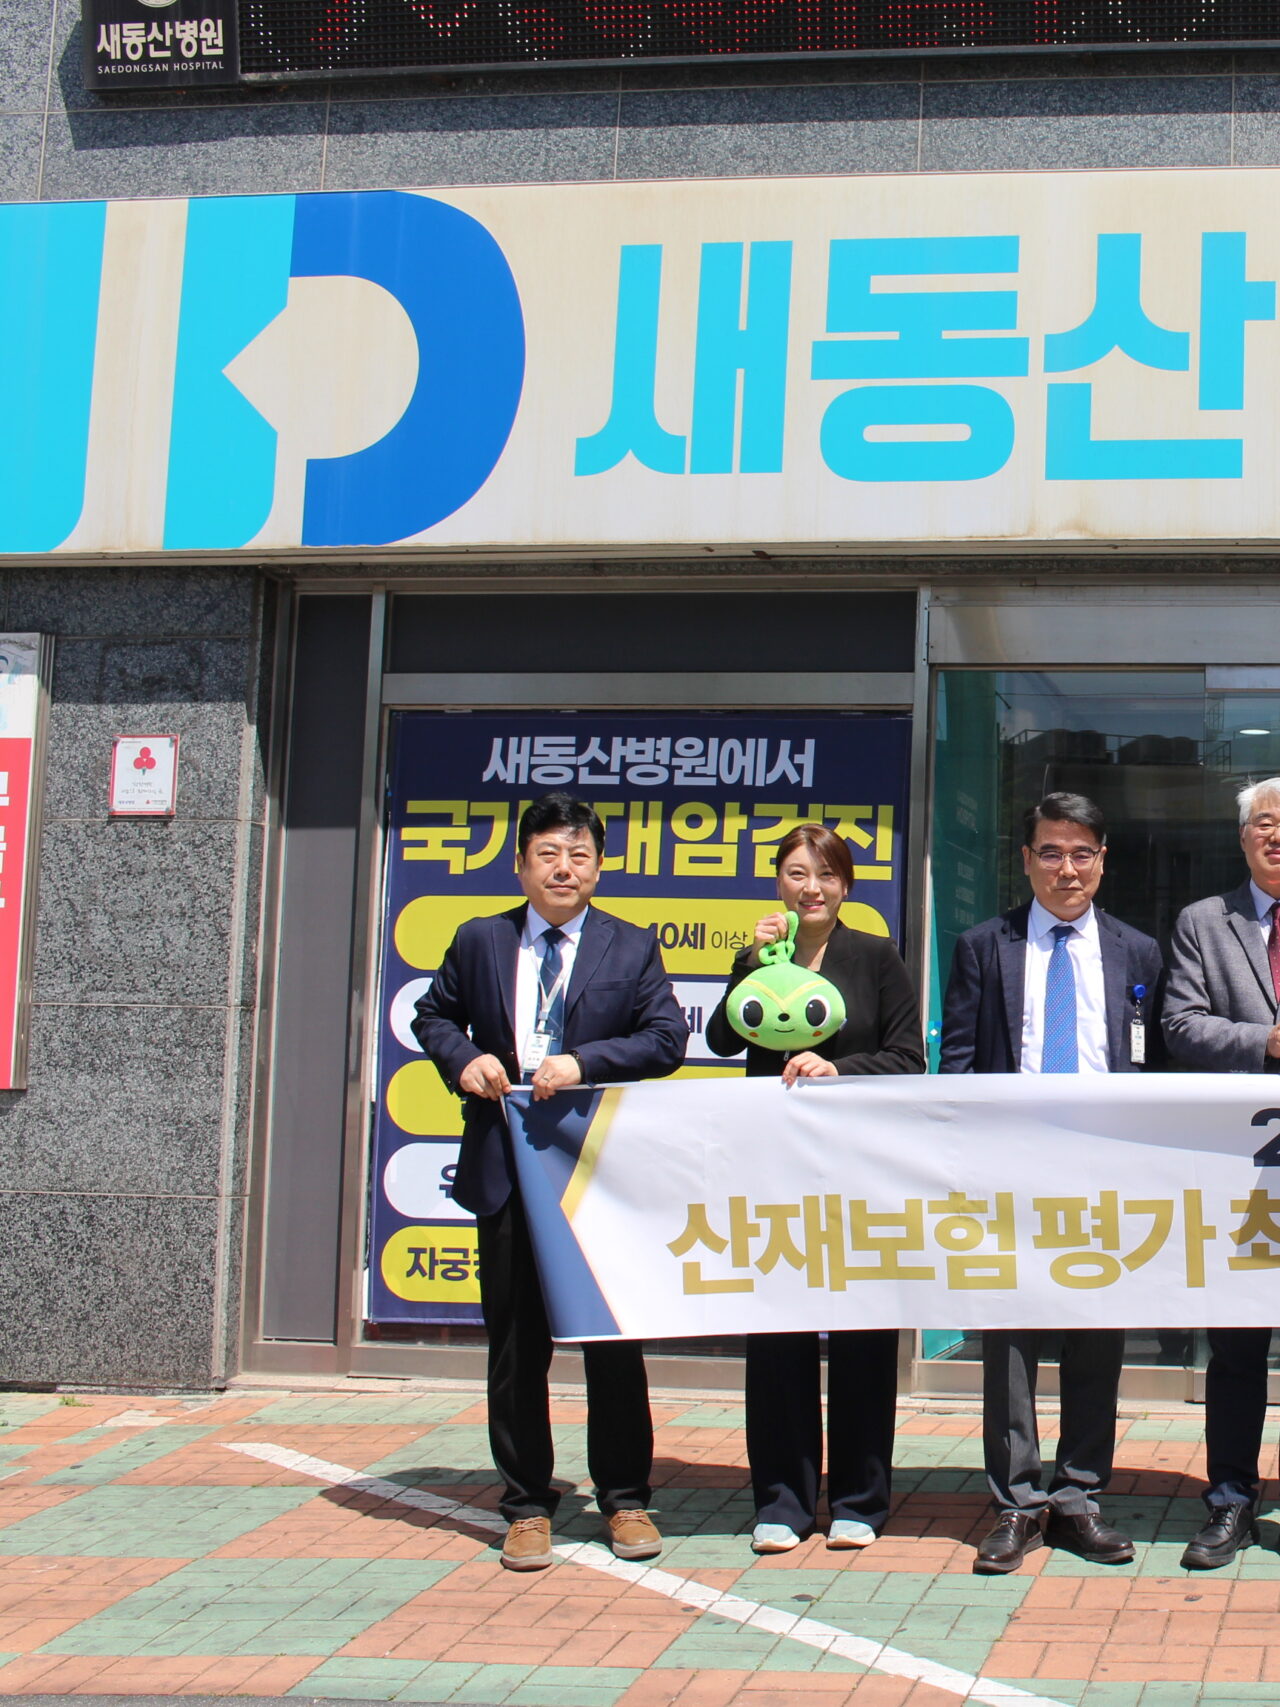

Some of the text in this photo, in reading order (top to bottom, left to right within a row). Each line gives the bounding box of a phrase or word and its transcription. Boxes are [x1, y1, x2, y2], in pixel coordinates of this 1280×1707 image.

[96, 18, 224, 60] 새동산병원
[97, 61, 225, 75] SAEDONGSAN HOSPITAL
[483, 736, 815, 788] 새동산병원에서
[400, 799, 894, 881] 국가대암검진
[711, 930, 748, 950] 이상
[666, 1191, 1018, 1295] 산재보험
[1031, 1188, 1217, 1290] 평가
